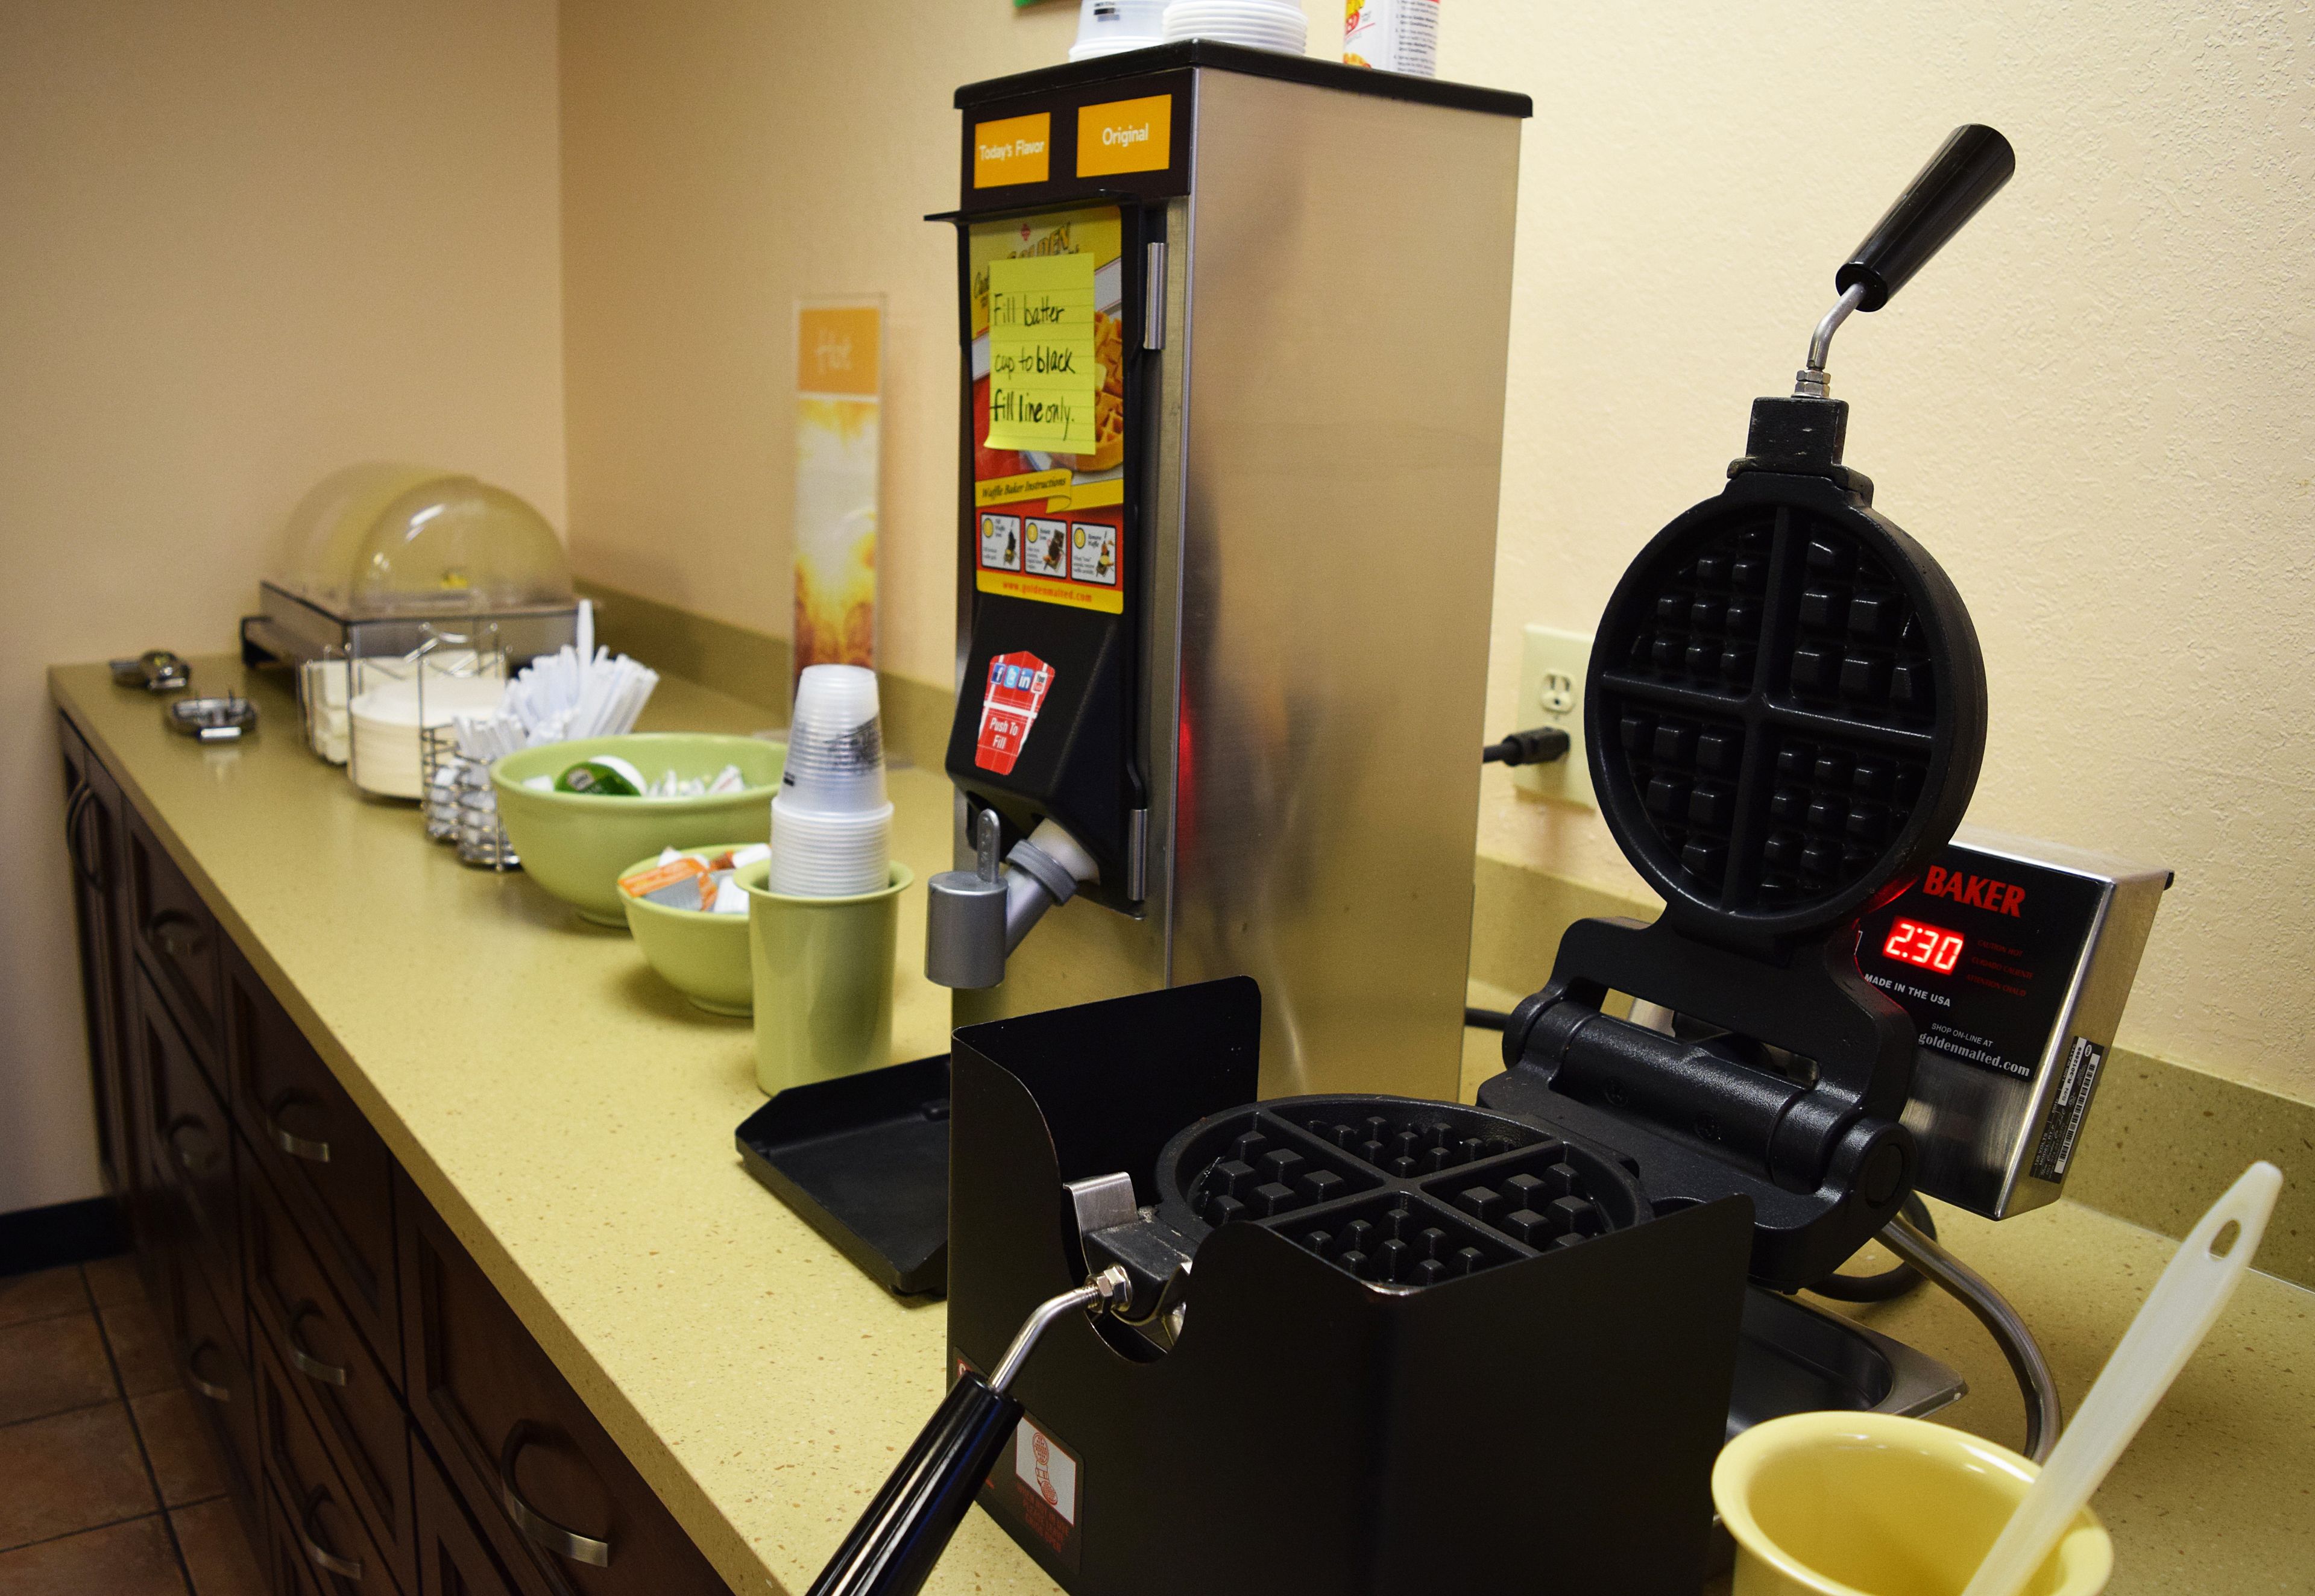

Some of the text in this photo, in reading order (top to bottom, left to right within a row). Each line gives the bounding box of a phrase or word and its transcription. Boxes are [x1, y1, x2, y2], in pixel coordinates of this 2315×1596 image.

[1103, 123, 1148, 147] Original
[979, 139, 1044, 161] Today's Flavor
[994, 294, 1065, 326] Fill batter
[995, 345, 1076, 380] cup to black
[991, 389, 1014, 421] fill
[1019, 393, 1043, 423] line
[983, 477, 1066, 500] Waffle Baker Instructions
[989, 717, 1019, 736] Push To
[992, 735, 1007, 749] Fill
[1923, 864, 2026, 918] BAKER
[1886, 922, 1964, 970] 2:30
[1978, 940, 2024, 957] CAUTION HOT
[1972, 957, 2034, 980] CUIDADO CALIENTE
[1864, 973, 1951, 1007] MADE IN THE USA
[1967, 974, 2001, 989] ATTENTION
[1931, 1023, 1952, 1034] SHOP
[1953, 1029, 1982, 1045] ON-LINE
[1918, 1032, 2030, 1076] goldenmalted.com
